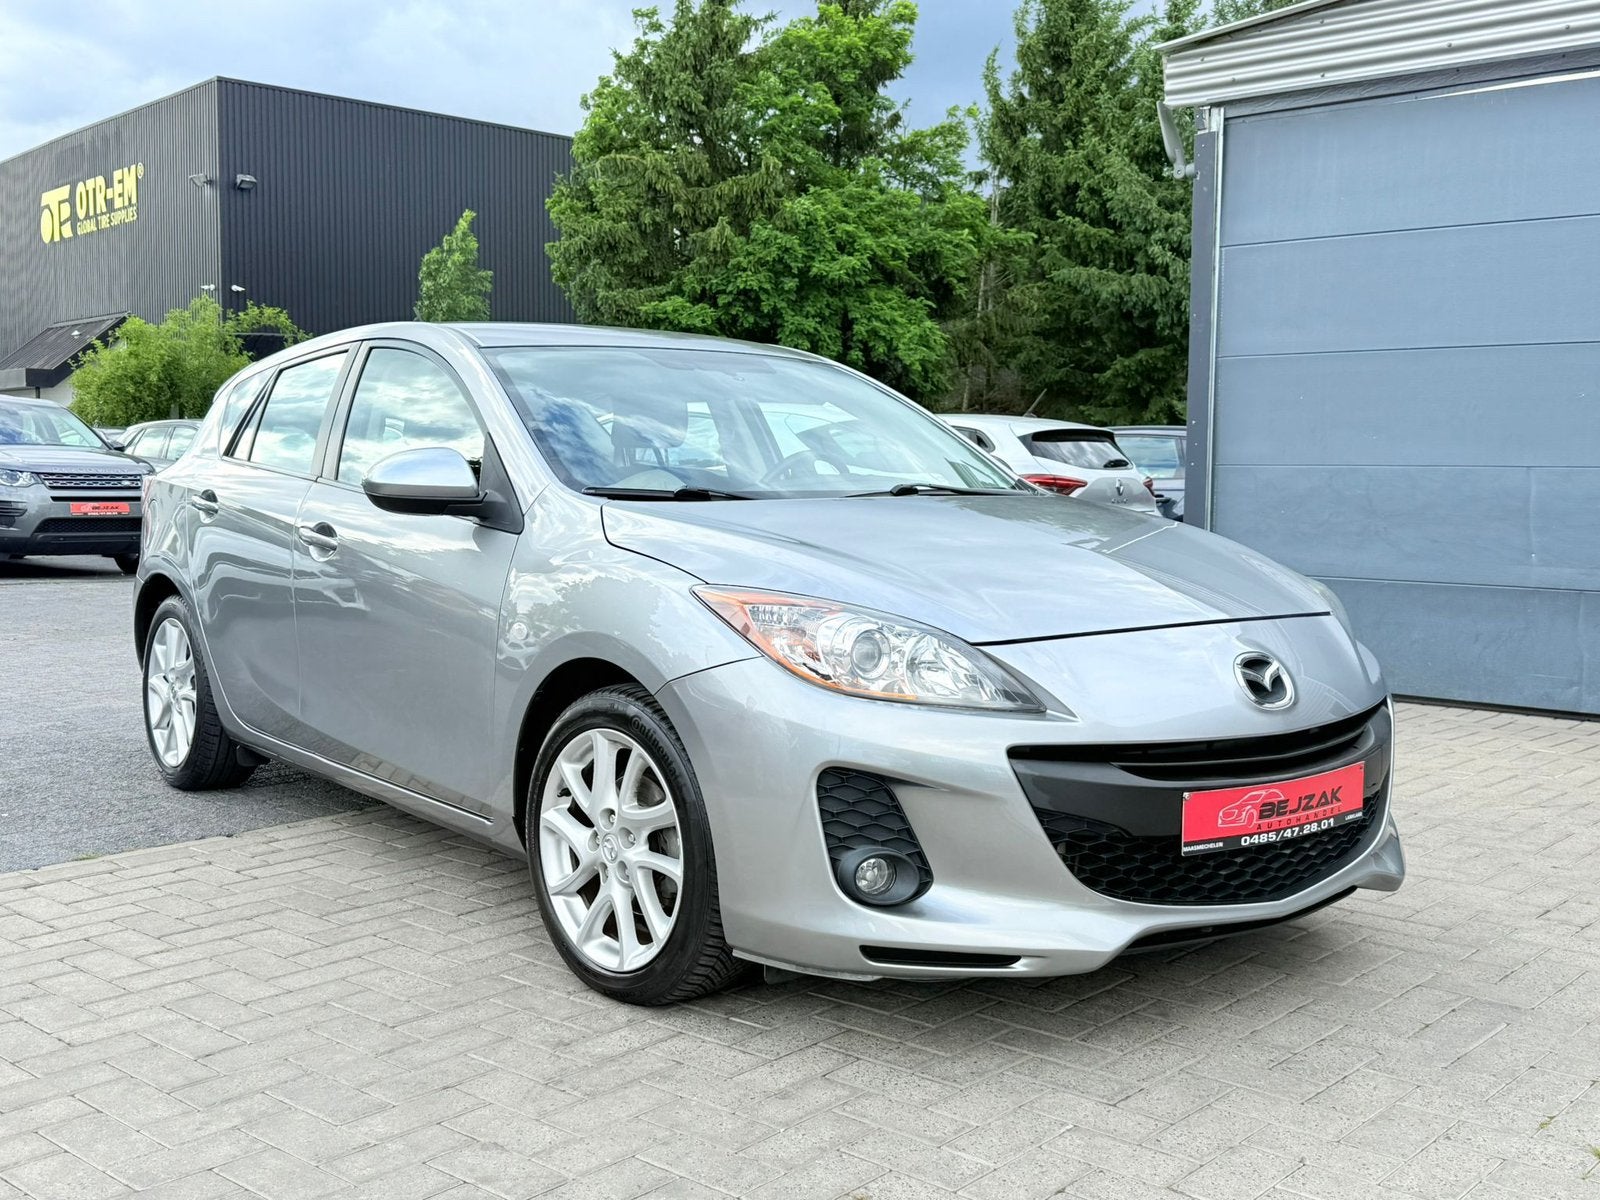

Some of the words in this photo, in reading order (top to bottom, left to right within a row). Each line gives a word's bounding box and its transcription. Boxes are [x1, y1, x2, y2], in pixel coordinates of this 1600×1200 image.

[97, 213, 110, 230] TIRE
[110, 205, 137, 226] SUPPLIES
[1258, 786, 1342, 820] BEJZAK
[1256, 806, 1342, 831] AUTOHANDEL
[1240, 818, 1335, 846] 0485/47.28.01
